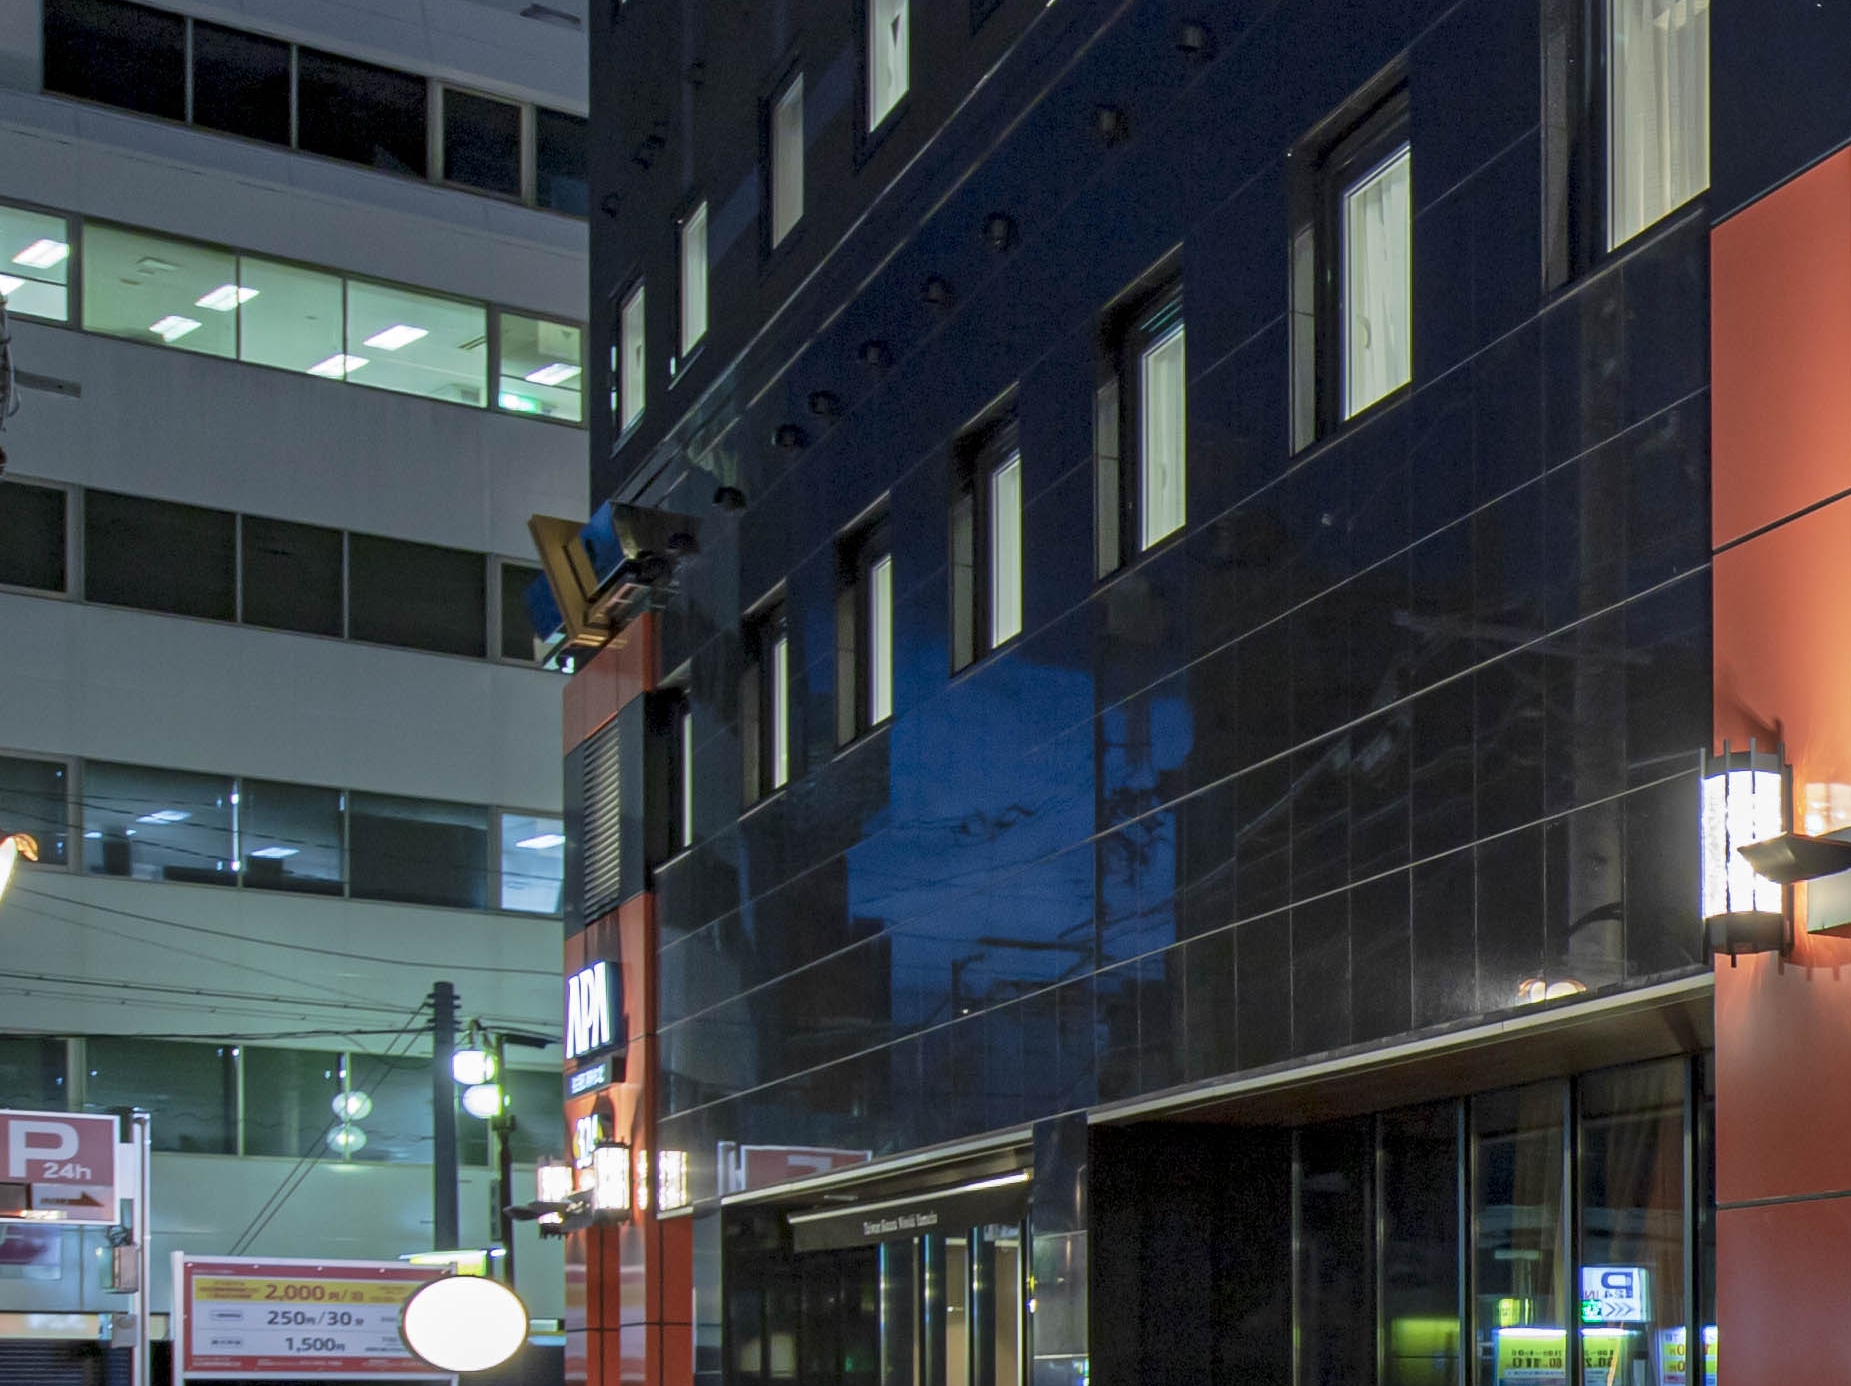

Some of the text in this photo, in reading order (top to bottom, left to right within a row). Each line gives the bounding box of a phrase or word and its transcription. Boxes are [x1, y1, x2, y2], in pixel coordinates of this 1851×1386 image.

[565, 959, 611, 1059] APA
[8, 1119, 80, 1179] P
[42, 1161, 93, 1181] 24h
